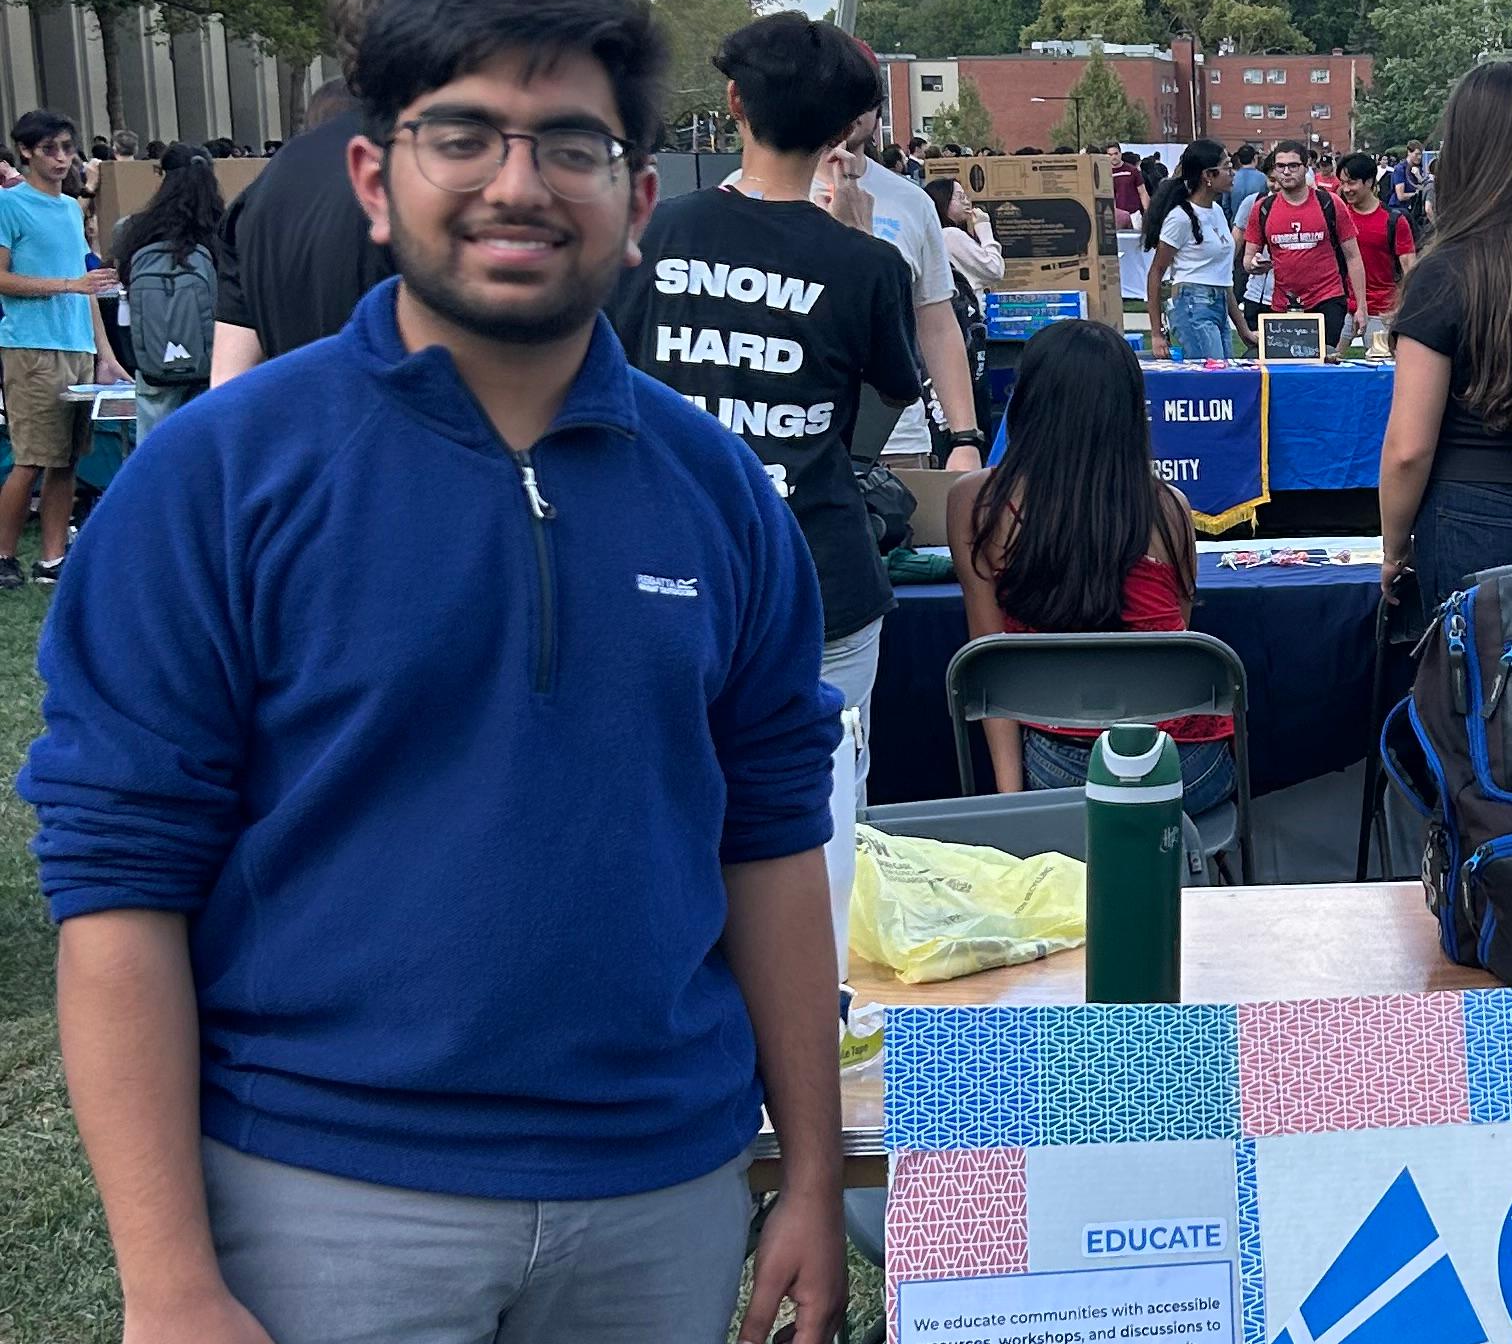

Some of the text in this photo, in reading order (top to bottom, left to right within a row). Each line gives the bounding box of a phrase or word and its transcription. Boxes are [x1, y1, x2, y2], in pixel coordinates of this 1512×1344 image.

[655, 258, 825, 315] SNOW
[655, 325, 804, 374] HARD
[1164, 399, 1234, 422] MELLON
[1151, 458, 1200, 481] RSITY
[1087, 1223, 1222, 1254] EDUCATE
[913, 1296, 1221, 1332] We educate communities with accessible
[1088, 1325, 1116, 1341] and
[1120, 1320, 1203, 1338] discussions
[1206, 1319, 1221, 1332] to
